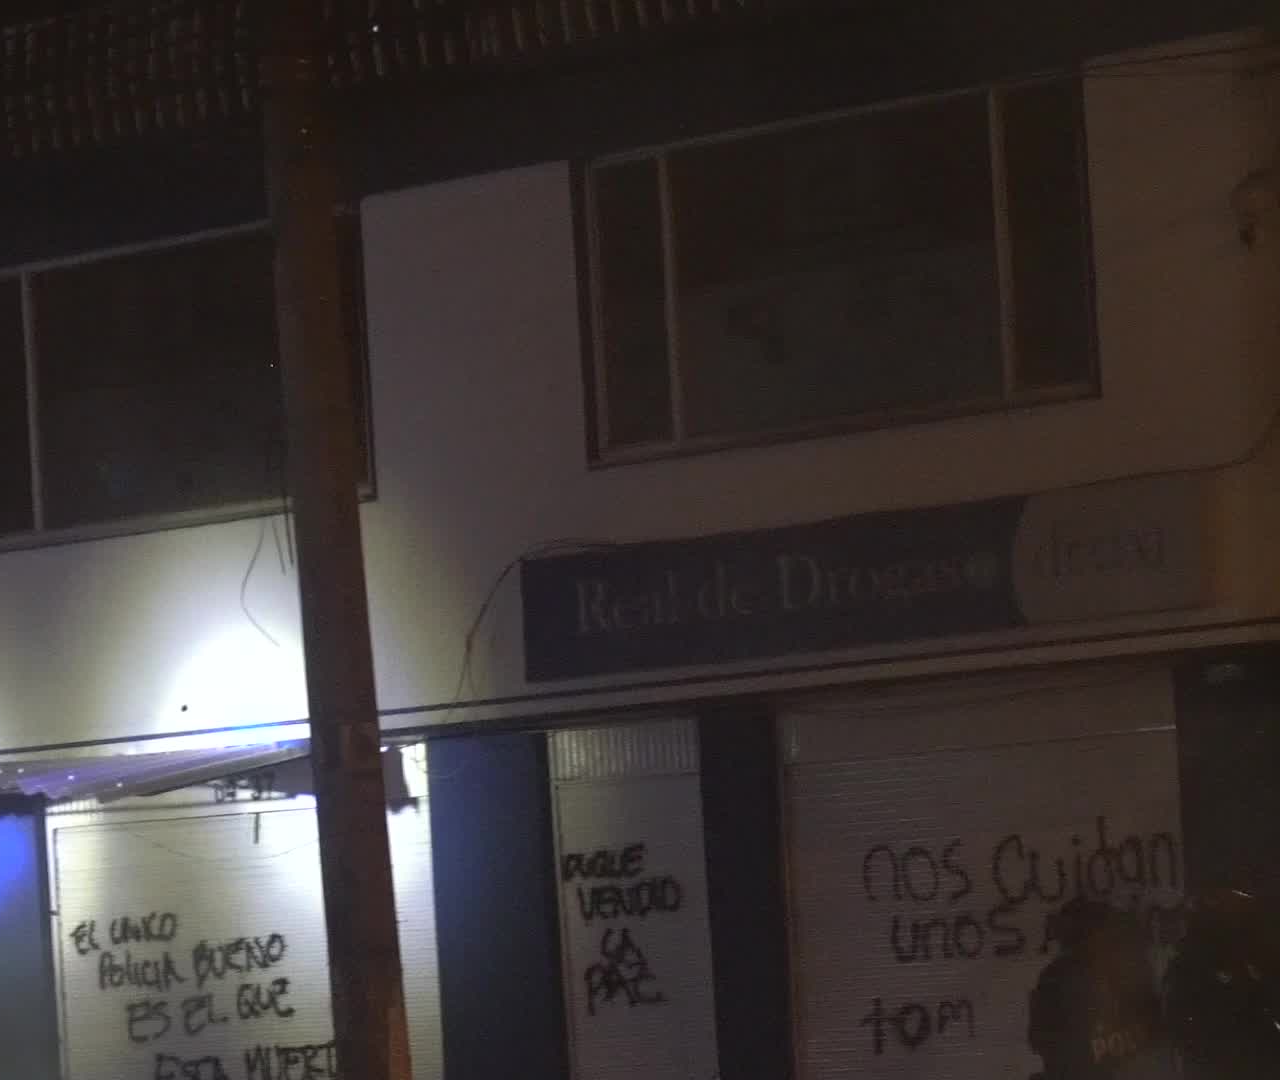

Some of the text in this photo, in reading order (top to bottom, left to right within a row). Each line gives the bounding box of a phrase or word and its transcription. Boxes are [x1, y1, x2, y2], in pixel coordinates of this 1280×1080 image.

[575, 552, 963, 634] Real de Drogas
[70, 919, 100, 955] EL
[193, 933, 288, 989] BUENO
[126, 999, 170, 1042] ES
